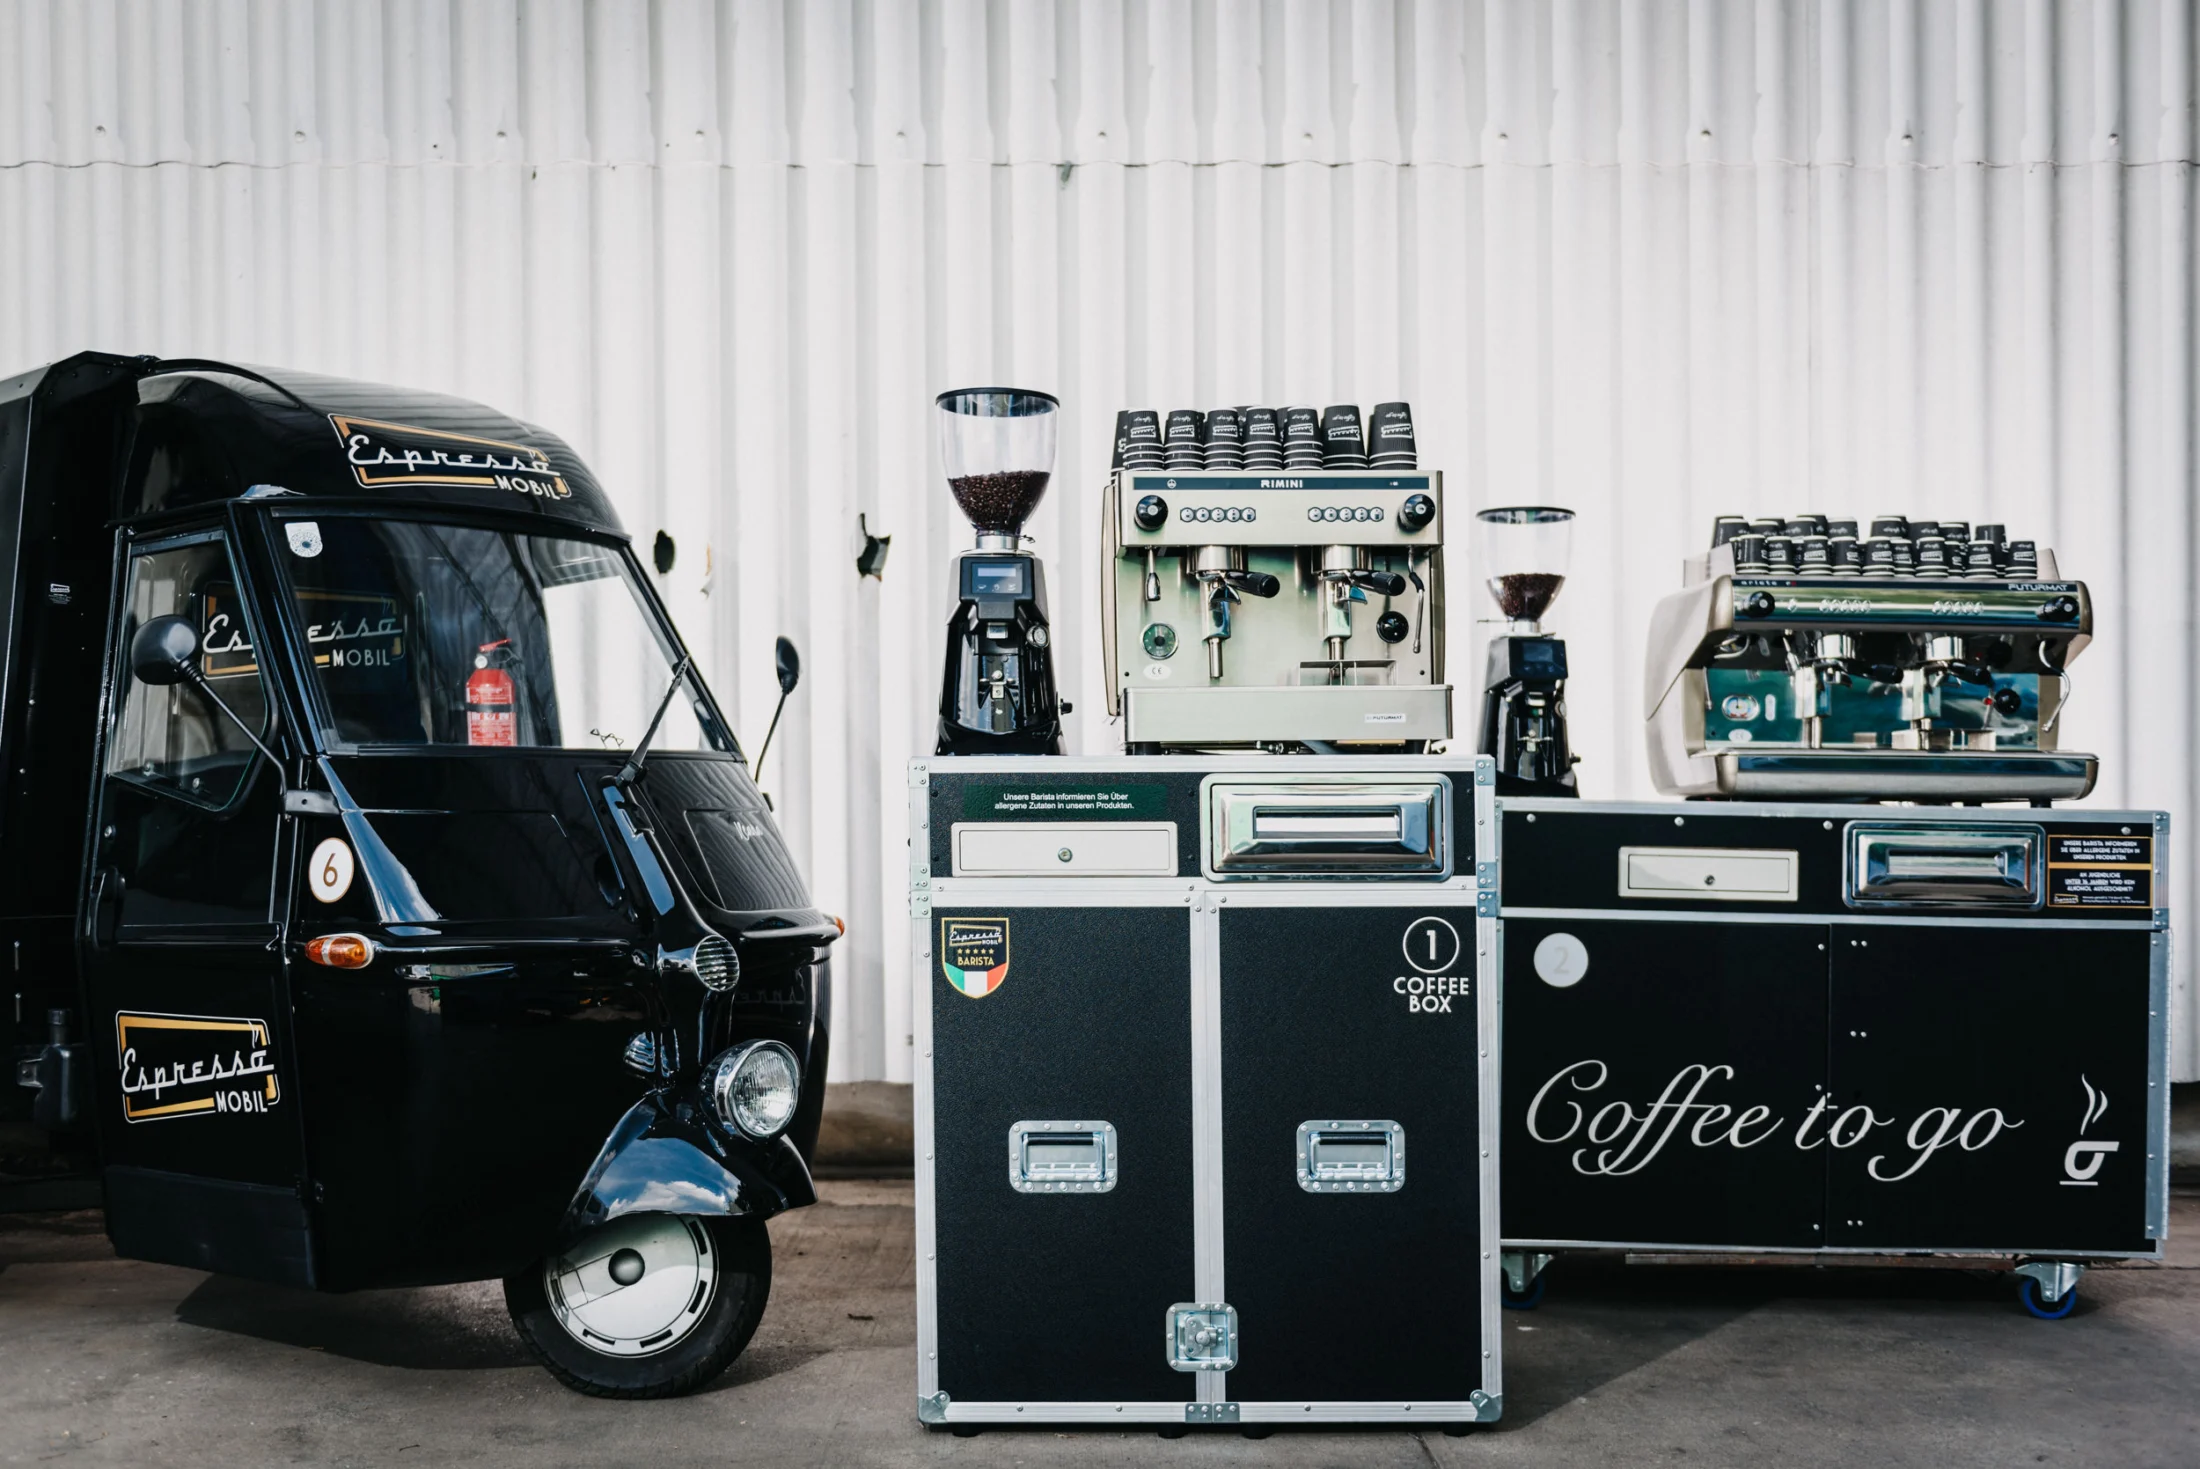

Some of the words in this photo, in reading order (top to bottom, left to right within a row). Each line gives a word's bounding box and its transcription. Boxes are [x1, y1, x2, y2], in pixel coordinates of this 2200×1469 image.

[348, 434, 561, 477] Espresso
[495, 474, 561, 500] MOBIL
[1260, 479, 1303, 489] RIMINI
[2007, 583, 2068, 592] FUTURMAT
[333, 648, 391, 667] MOBIL
[1003, 792, 1030, 801] Unsere
[1030, 792, 1055, 801] Barista
[1056, 792, 1096, 801] informieren
[1097, 792, 1109, 801] Sie
[1110, 791, 1128, 801] Über
[994, 802, 1028, 811] allergene
[1029, 801, 1056, 810] Zutaten
[1057, 801, 1065, 810] in
[1066, 802, 1095, 810] unseren
[1096, 801, 1135, 810] Produkten.
[323, 853, 338, 887] 6
[949, 930, 1002, 942] Espresso
[1426, 929, 1436, 960] 1
[957, 956, 995, 966] BARISTA
[1553, 946, 1570, 974] 2
[1393, 976, 1469, 995] COFFEE
[1409, 994, 1452, 1013] BOX
[121, 1047, 275, 1100] Espresso
[215, 1090, 268, 1112] MOBIL
[1526, 1060, 1783, 1175] Coffee
[1795, 1091, 1895, 1150] to
[1867, 1106, 2025, 1182] go
